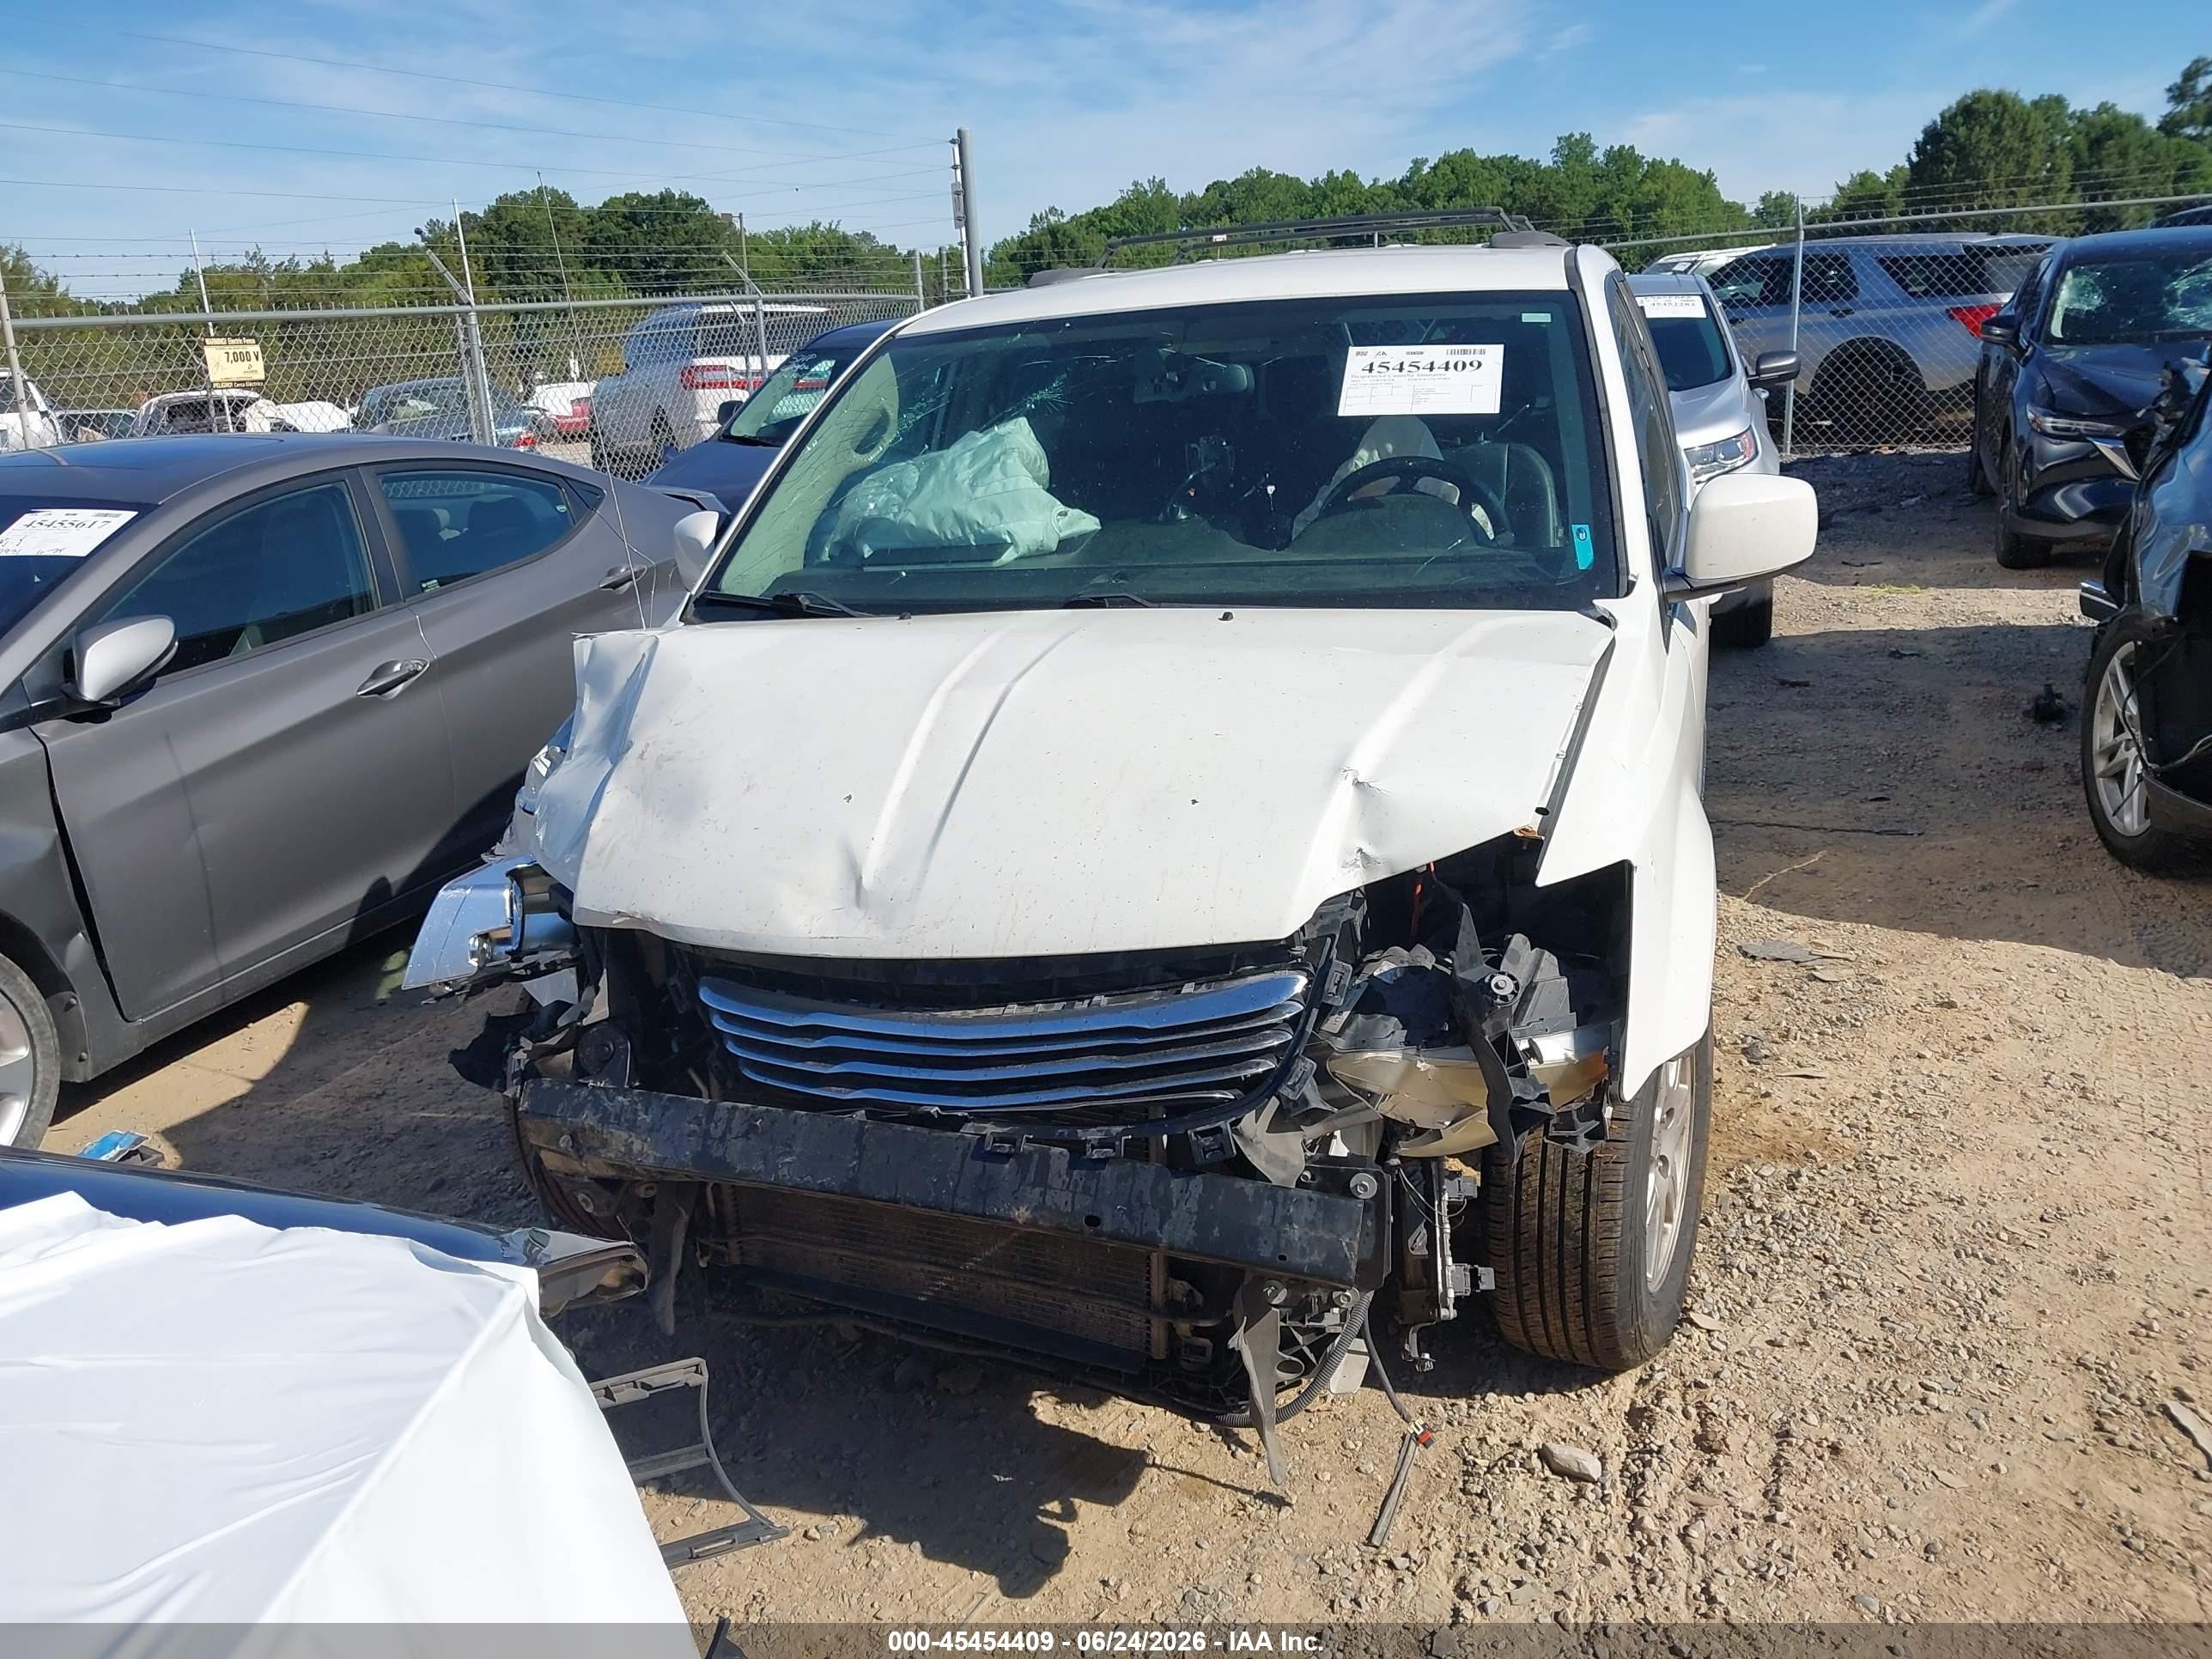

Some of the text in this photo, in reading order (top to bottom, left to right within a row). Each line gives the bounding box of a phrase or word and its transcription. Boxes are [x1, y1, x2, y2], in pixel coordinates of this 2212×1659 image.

[225, 350, 259, 364] 7,000 V
[1361, 359, 1483, 374] 45454409
